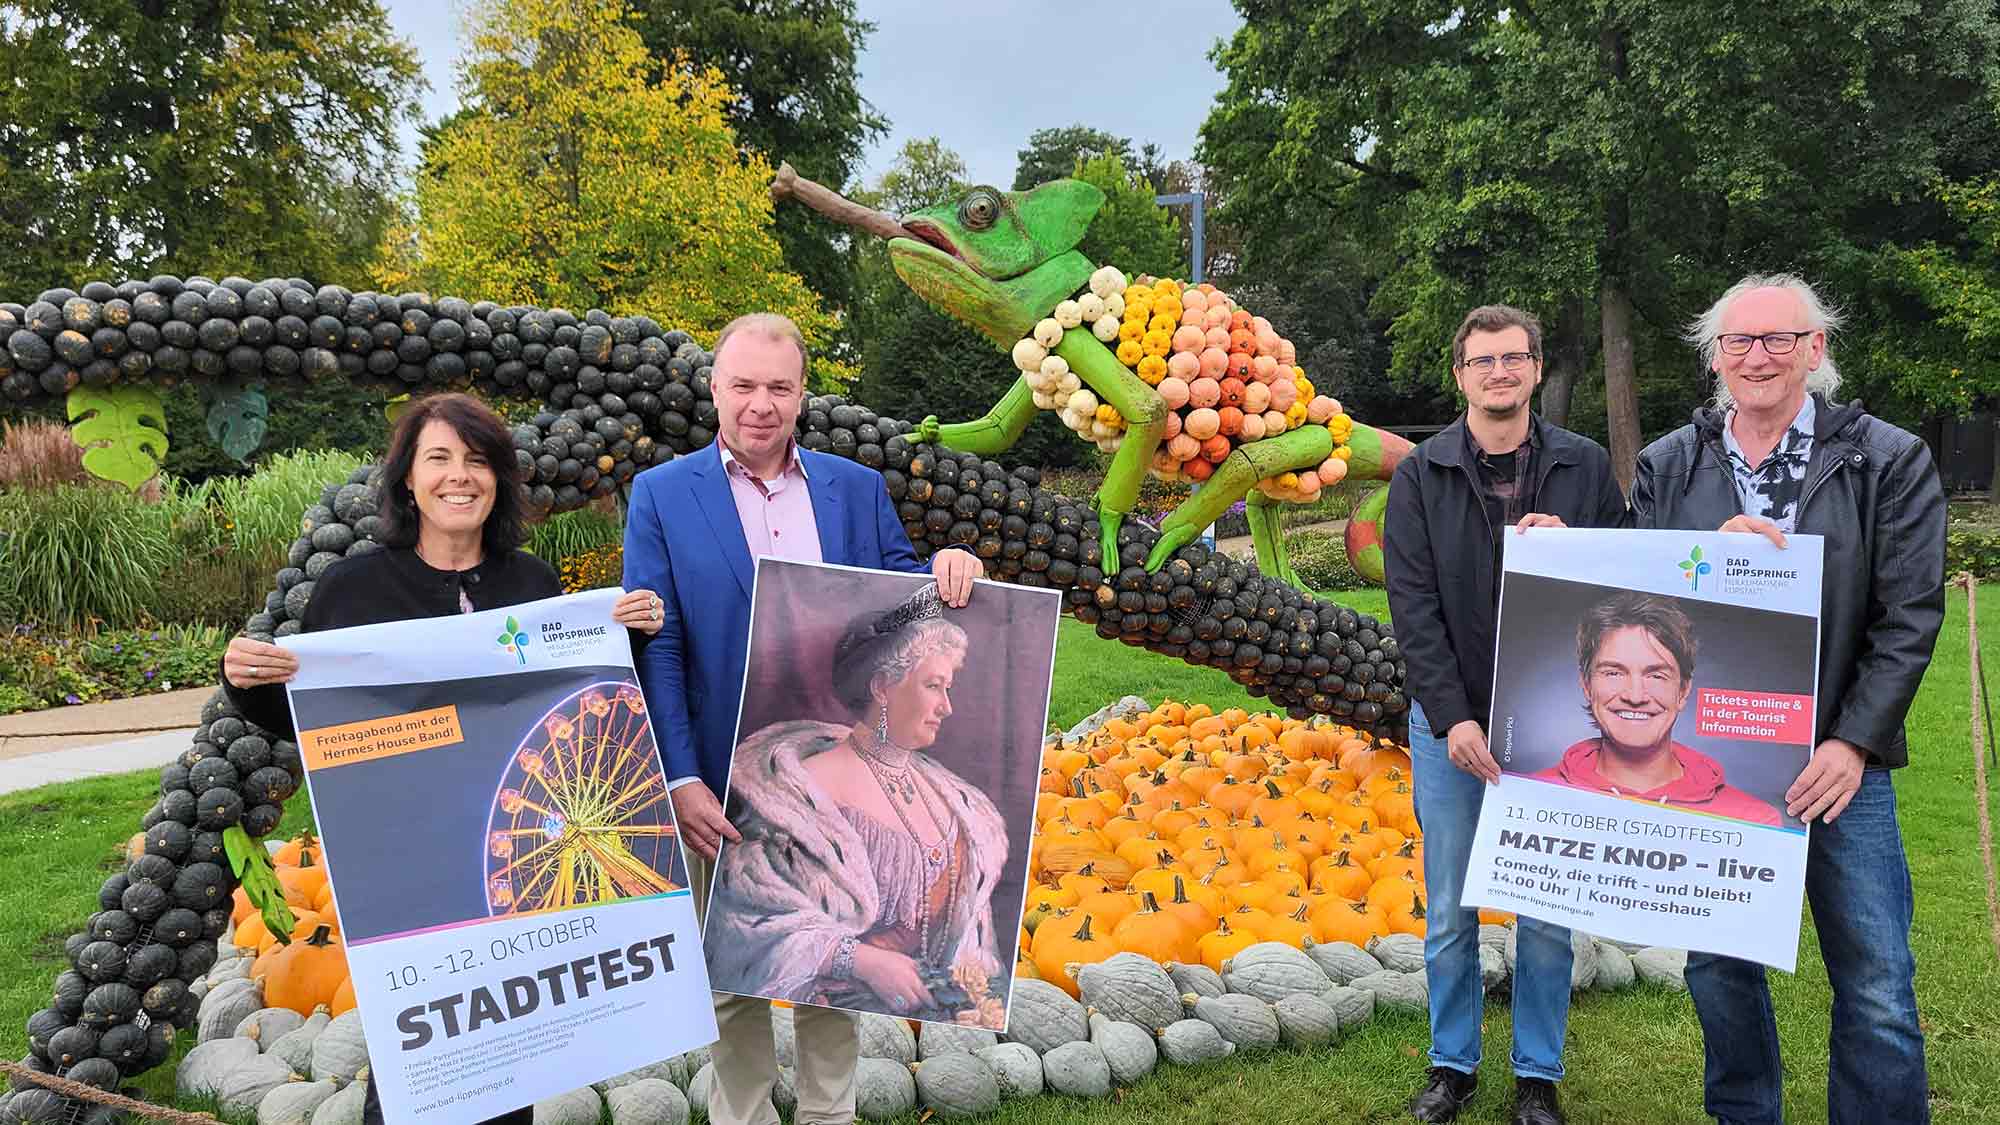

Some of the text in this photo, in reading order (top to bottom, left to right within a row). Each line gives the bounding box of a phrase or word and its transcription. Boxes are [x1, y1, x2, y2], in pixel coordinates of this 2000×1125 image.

[1726, 568, 1798, 579] LIPPSPRINGE
[1727, 558, 1750, 567] BAD
[541, 622, 562, 632] BAD
[543, 626, 606, 643] LIPPSPRINGE
[1703, 693, 1802, 711] Tickets online &
[1717, 708, 1738, 719] der
[1742, 711, 1787, 723] Tourist
[316, 715, 450, 746] Freitagabend mit der
[323, 727, 455, 761] Hermes House Band!
[1701, 721, 1776, 737] Information
[1506, 806, 1743, 847] 11. OKTOBER (STADTFEST)
[1499, 829, 1597, 861] MATZE
[1603, 844, 1688, 872] KNOP
[1718, 858, 1776, 883] live
[1491, 871, 1535, 889] 14.00
[1540, 881, 1569, 896] Uhr
[1588, 888, 1712, 918] Kongresshaus
[1494, 856, 1561, 880] Comedy,
[1567, 869, 1592, 883] die
[1597, 872, 1638, 890] trifft
[1655, 883, 1689, 897] und
[1693, 885, 1752, 904] bleibt!
[1487, 887, 1595, 917] www.bad-lippspringe.de
[386, 964, 427, 992] 10.
[491, 915, 599, 961] OKTOBER
[396, 933, 676, 1051] STADTFEST
[414, 1077, 514, 1115] www.bad-lippspringe.de
